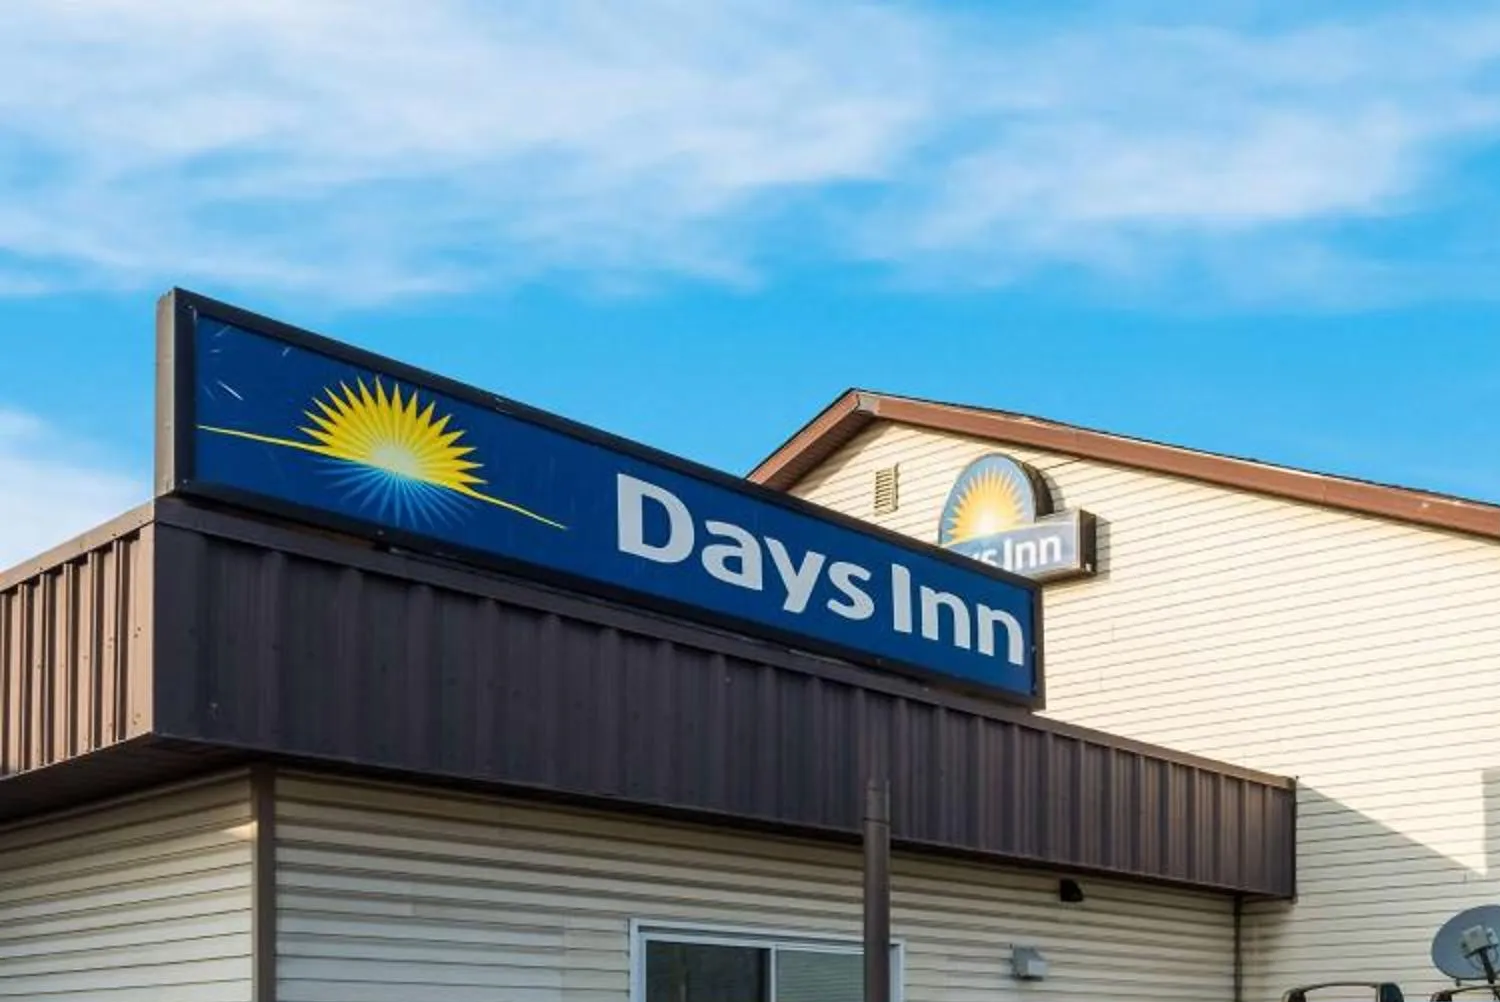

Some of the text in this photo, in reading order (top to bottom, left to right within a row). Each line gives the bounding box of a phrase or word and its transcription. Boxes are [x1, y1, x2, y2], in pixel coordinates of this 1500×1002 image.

[616, 473, 1024, 666] Days Inn
[1003, 536, 1061, 572] Inn
